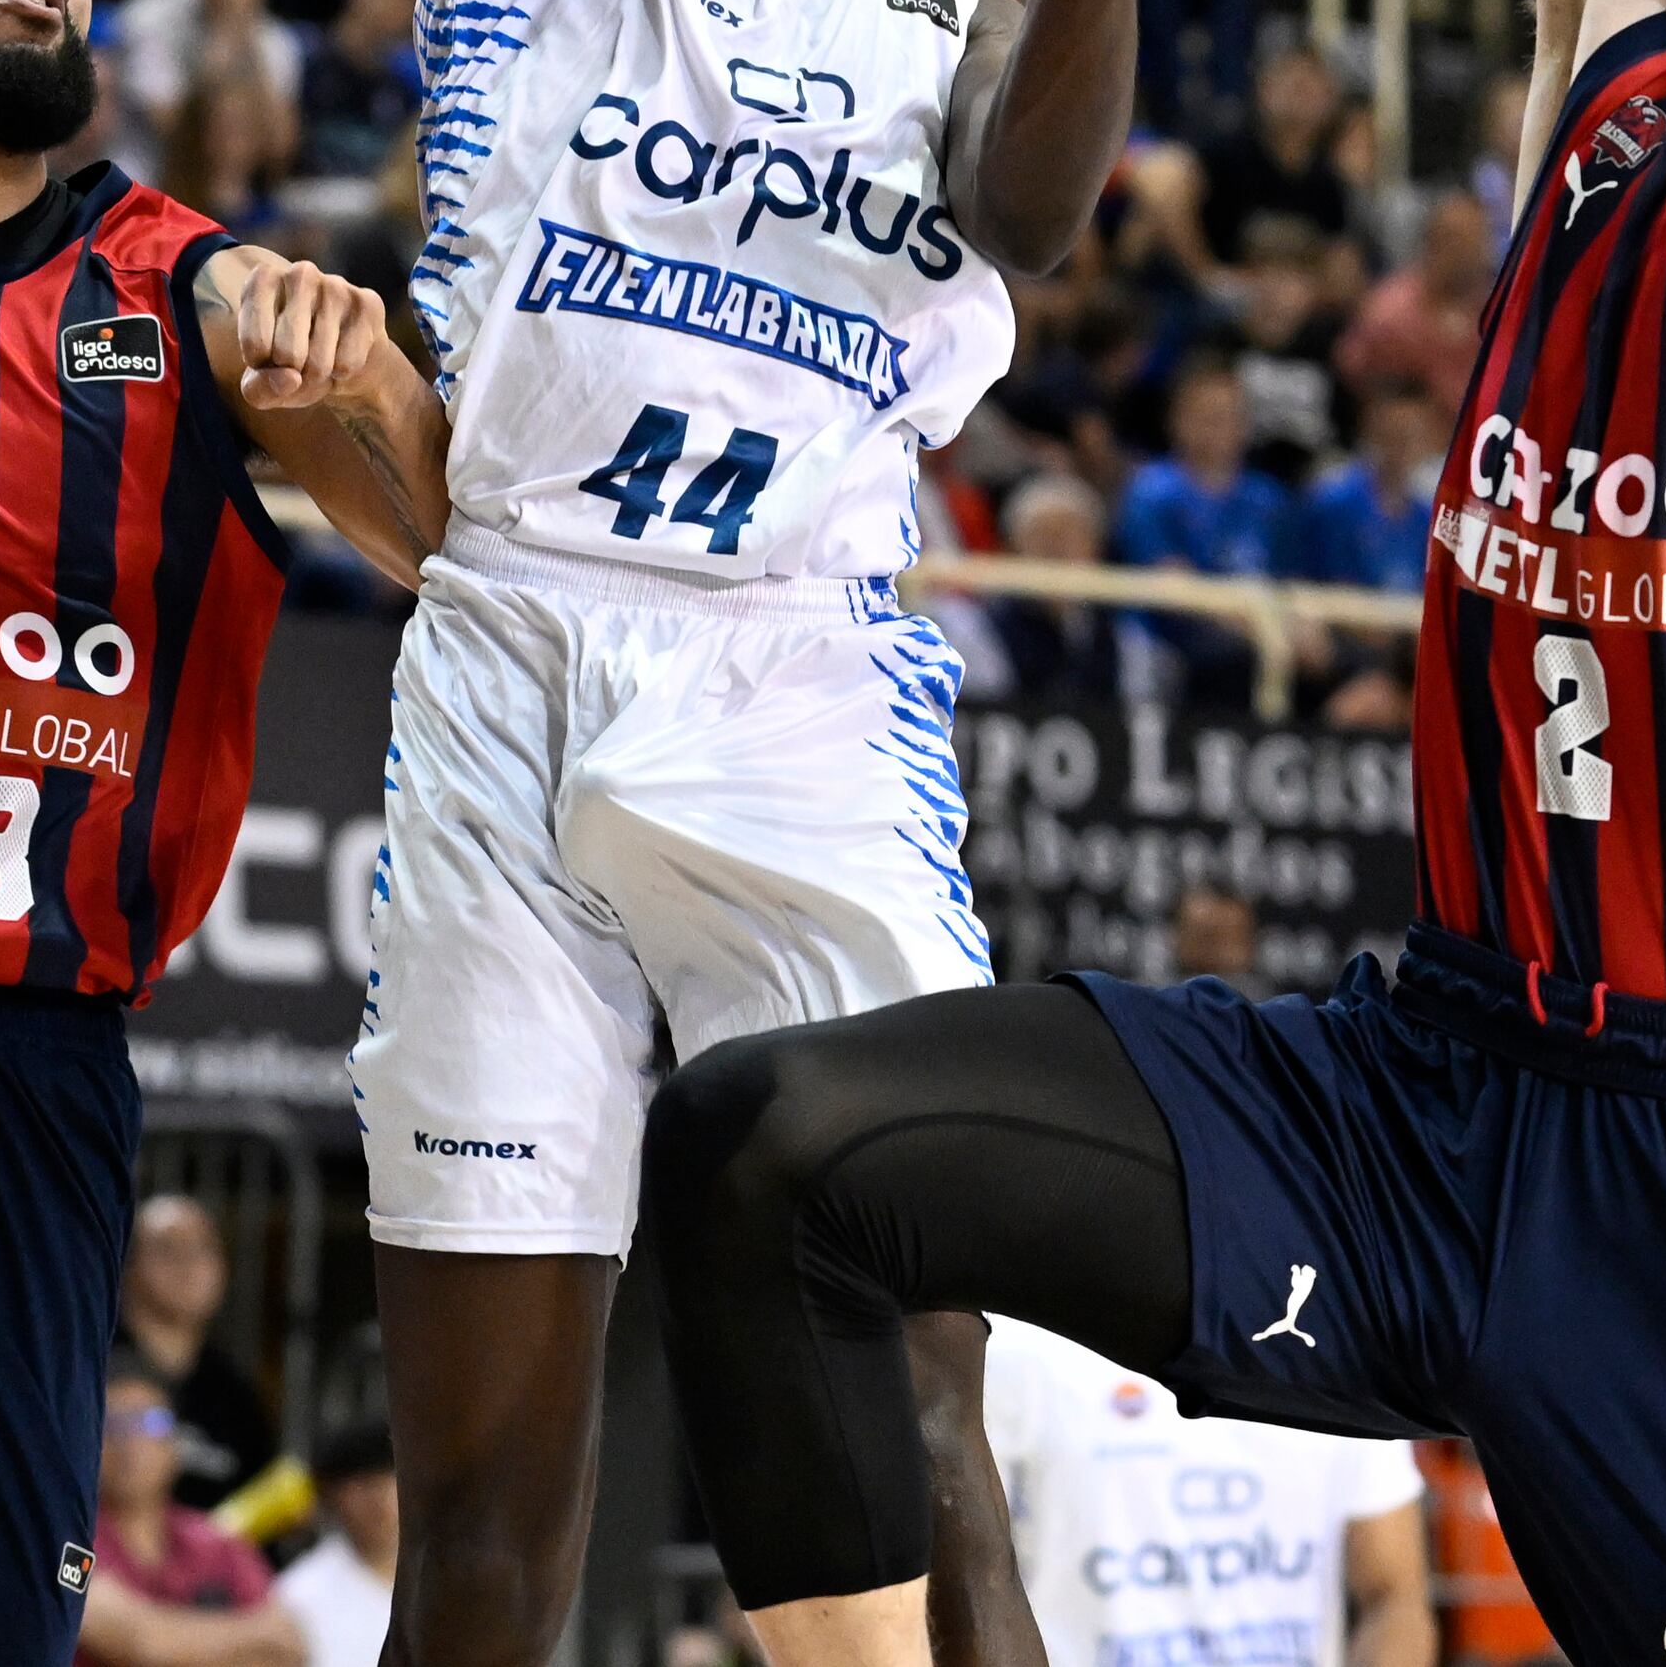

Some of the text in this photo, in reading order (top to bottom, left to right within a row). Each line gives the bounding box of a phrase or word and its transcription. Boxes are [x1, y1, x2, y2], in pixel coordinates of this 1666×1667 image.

[569, 94, 963, 281] carplus
[73, 340, 112, 357] liga
[74, 353, 157, 372] endesa
[528, 238, 899, 403] FUENLABRADA
[578, 404, 780, 556] 44
[1477, 525, 1568, 615] ETL
[1533, 634, 1613, 822] 2
[414, 1129, 537, 1160] Kromex
[62, 1563, 82, 1585] acb
